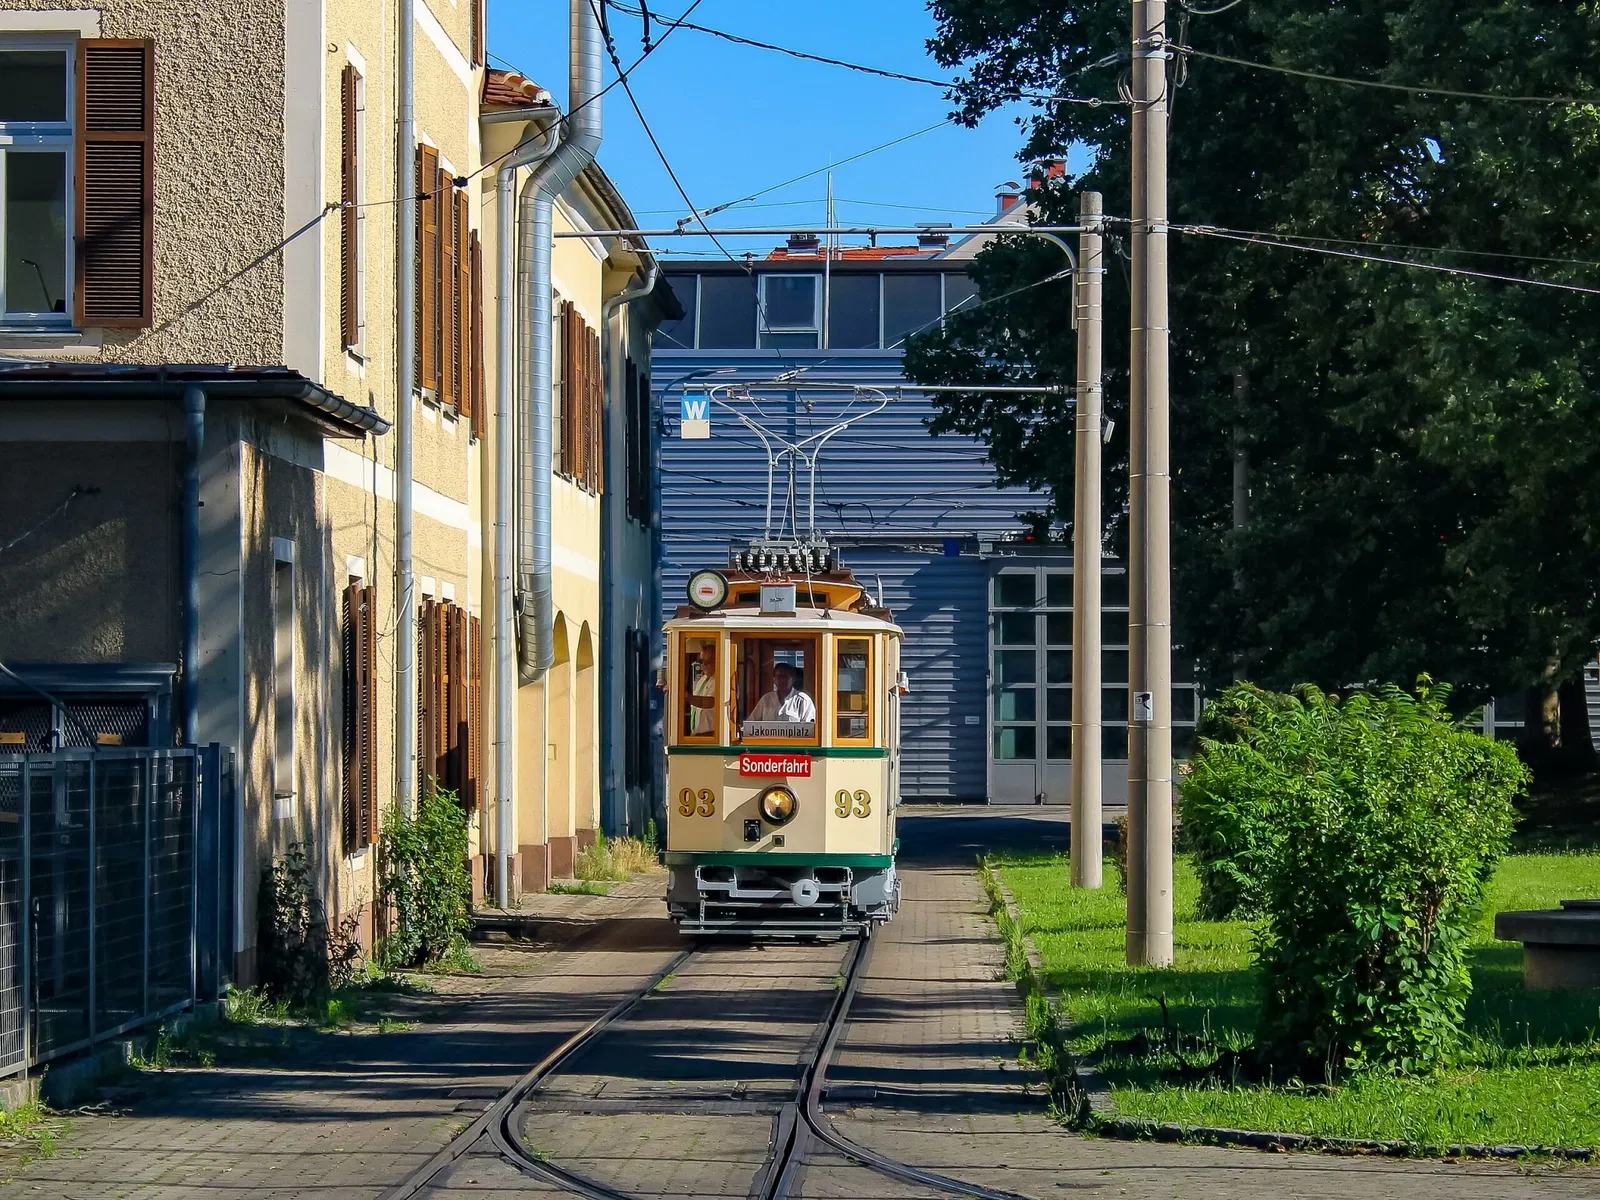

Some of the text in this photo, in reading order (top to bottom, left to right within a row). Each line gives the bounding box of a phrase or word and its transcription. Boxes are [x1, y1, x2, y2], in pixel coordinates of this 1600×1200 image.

[684, 401, 706, 420] W
[749, 725, 809, 738] Jakominiplatz
[742, 757, 809, 774] Sonderfahrt
[678, 787, 716, 818] 93
[834, 789, 871, 818] 93
